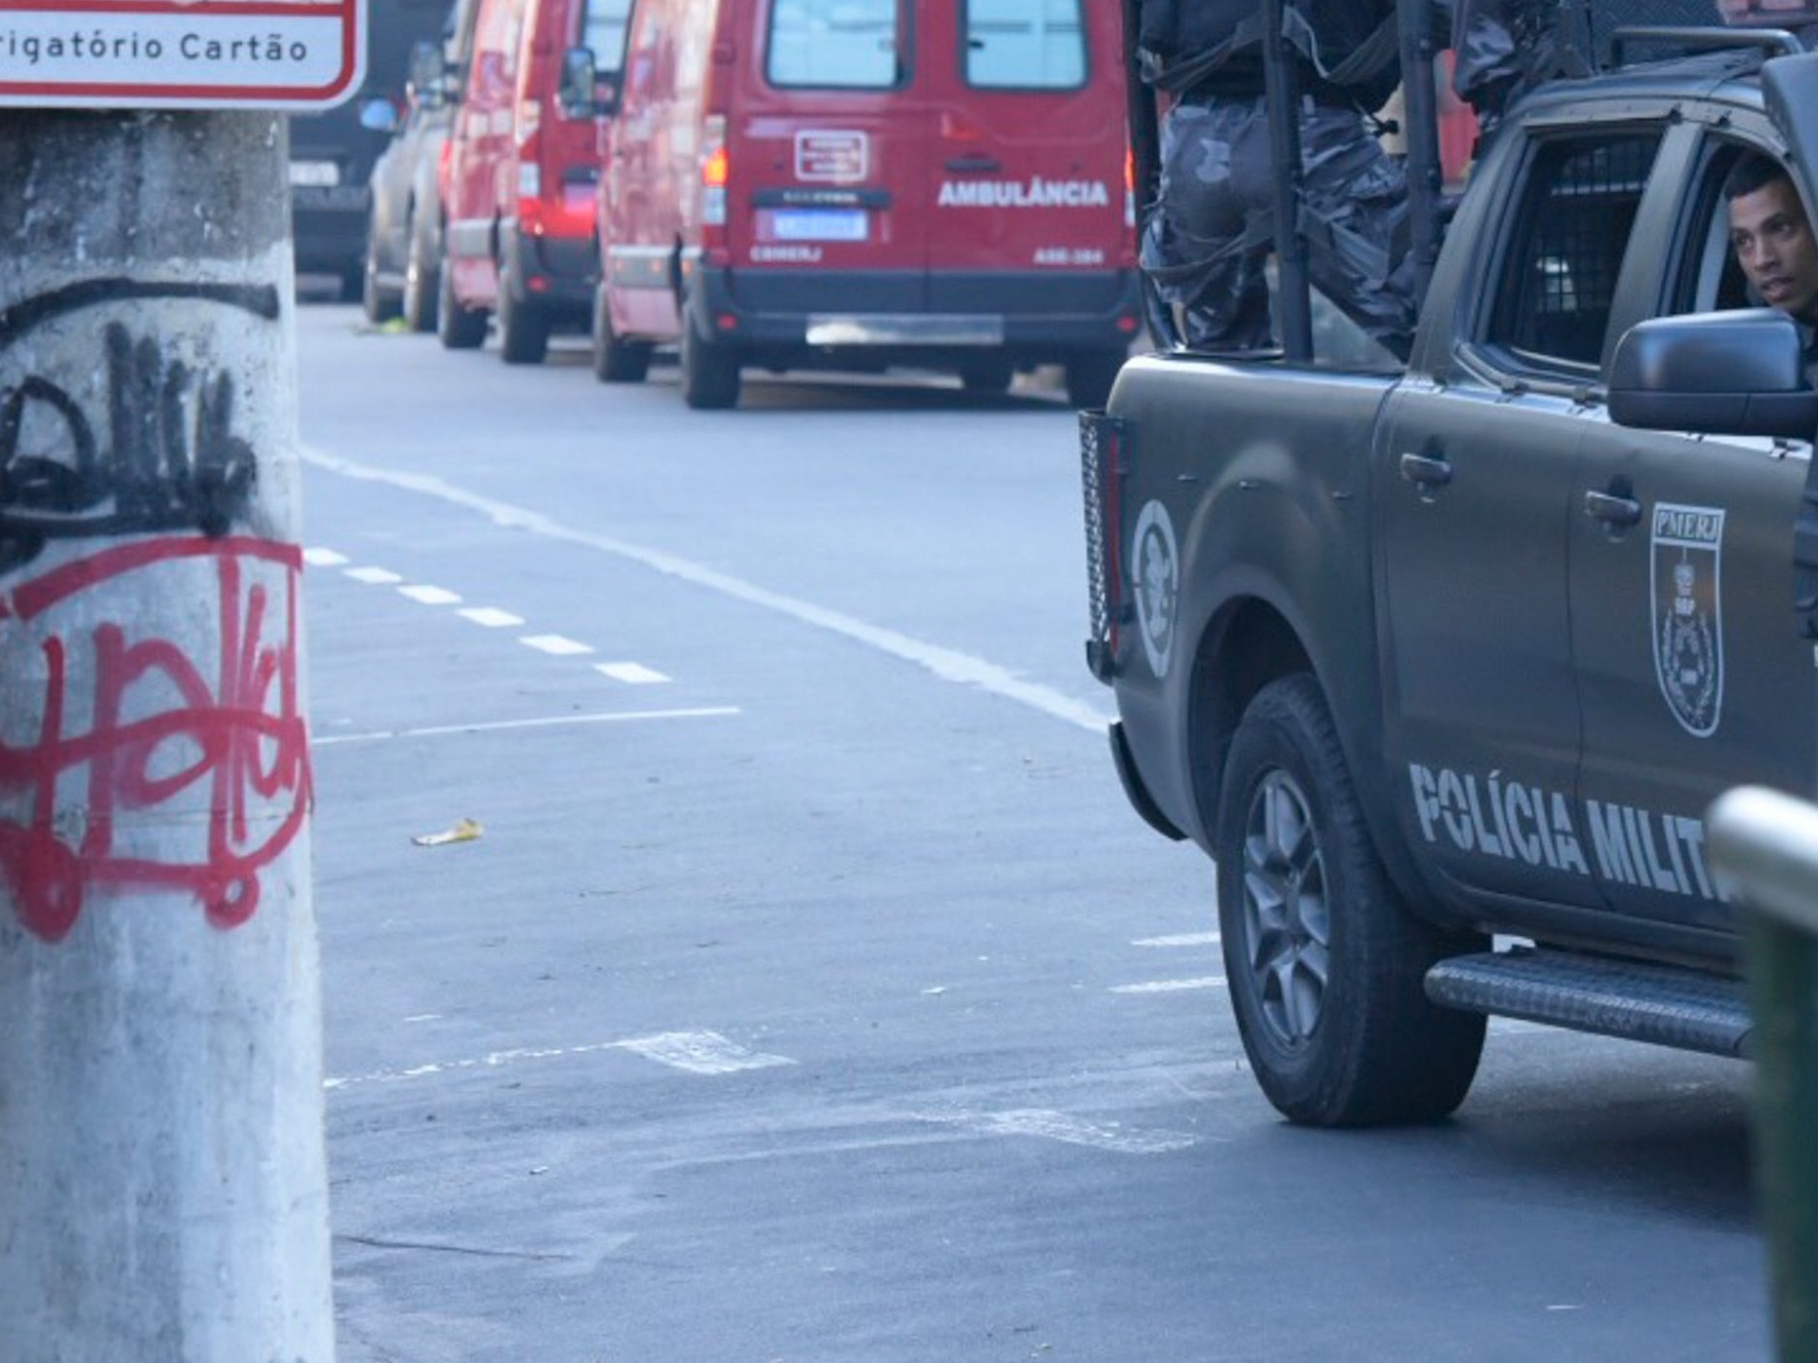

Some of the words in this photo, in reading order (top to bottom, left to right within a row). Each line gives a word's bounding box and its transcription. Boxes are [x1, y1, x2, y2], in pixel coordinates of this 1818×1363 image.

[0, 29, 162, 65] igatório
[179, 32, 308, 62] Cartão
[937, 175, 1109, 207] AMBULÂNCIA
[1657, 511, 1720, 543] PMERJ
[1409, 763, 1590, 876] POLÍCIA
[1586, 799, 1736, 903] MILIT
